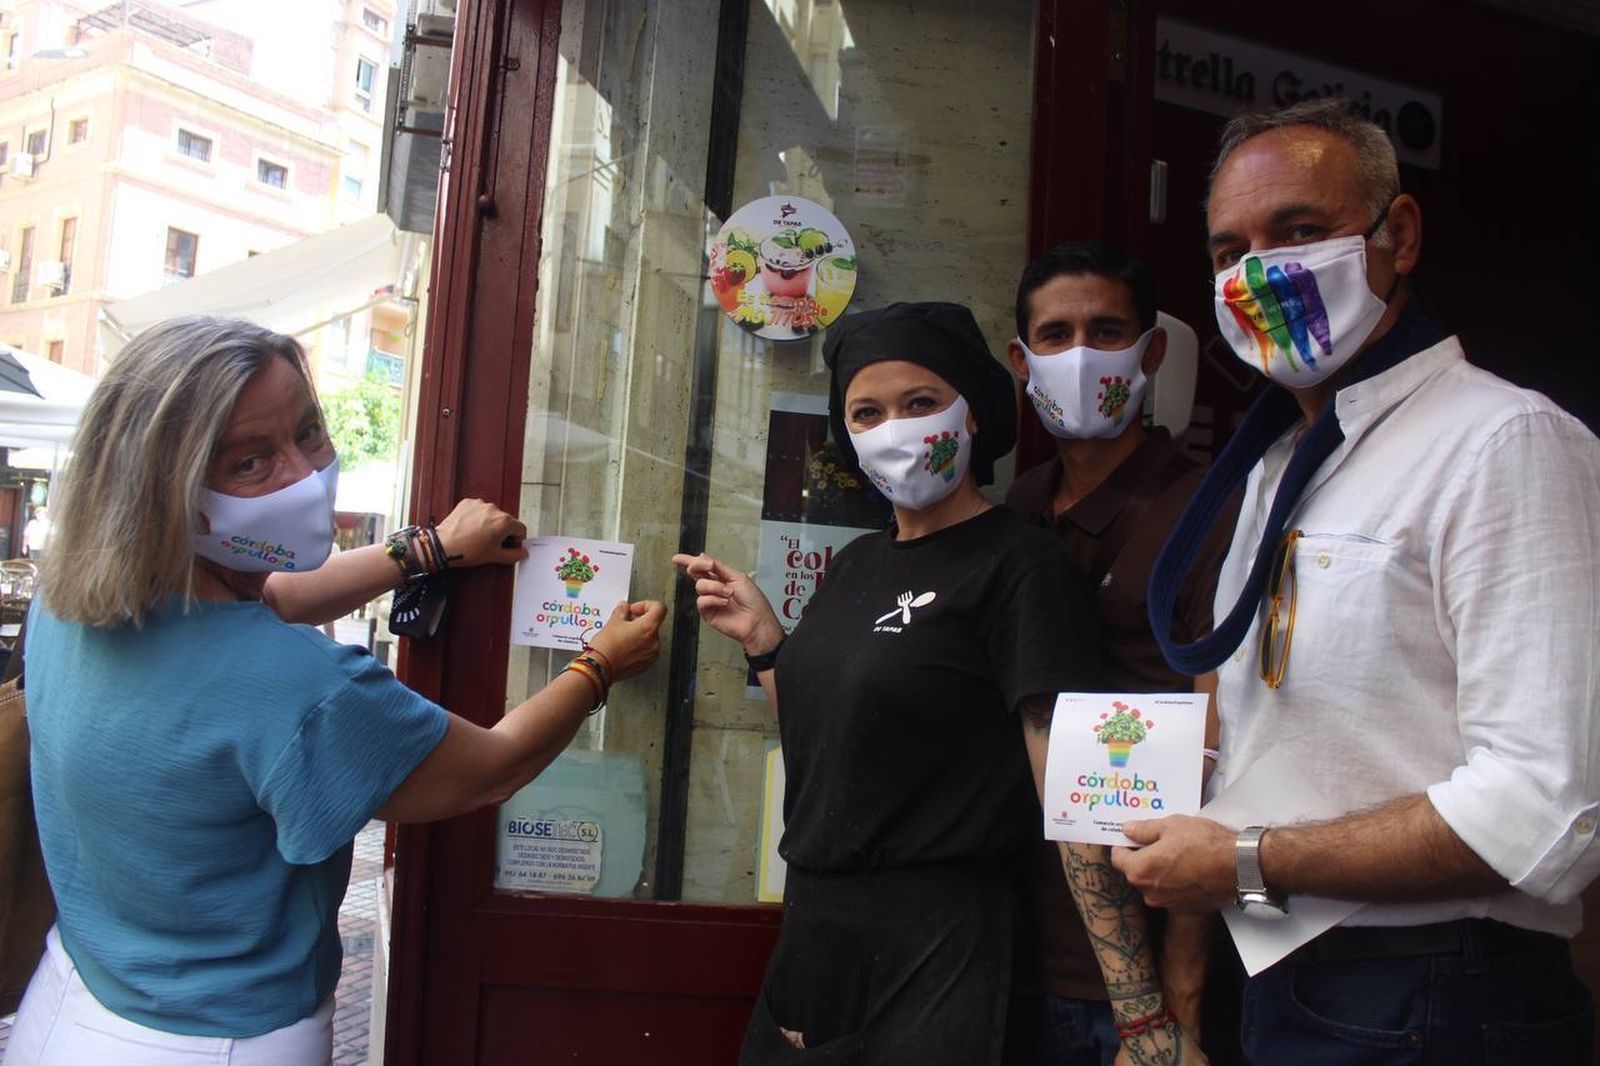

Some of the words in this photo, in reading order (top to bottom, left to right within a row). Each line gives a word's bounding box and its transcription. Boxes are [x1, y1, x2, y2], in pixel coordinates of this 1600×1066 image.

[231, 536, 296, 559] córdoba
[785, 571, 798, 579] en
[800, 570, 814, 580] los
[784, 581, 806, 597] de
[542, 600, 601, 617] córdoba
[1077, 772, 1160, 792] córdoba
